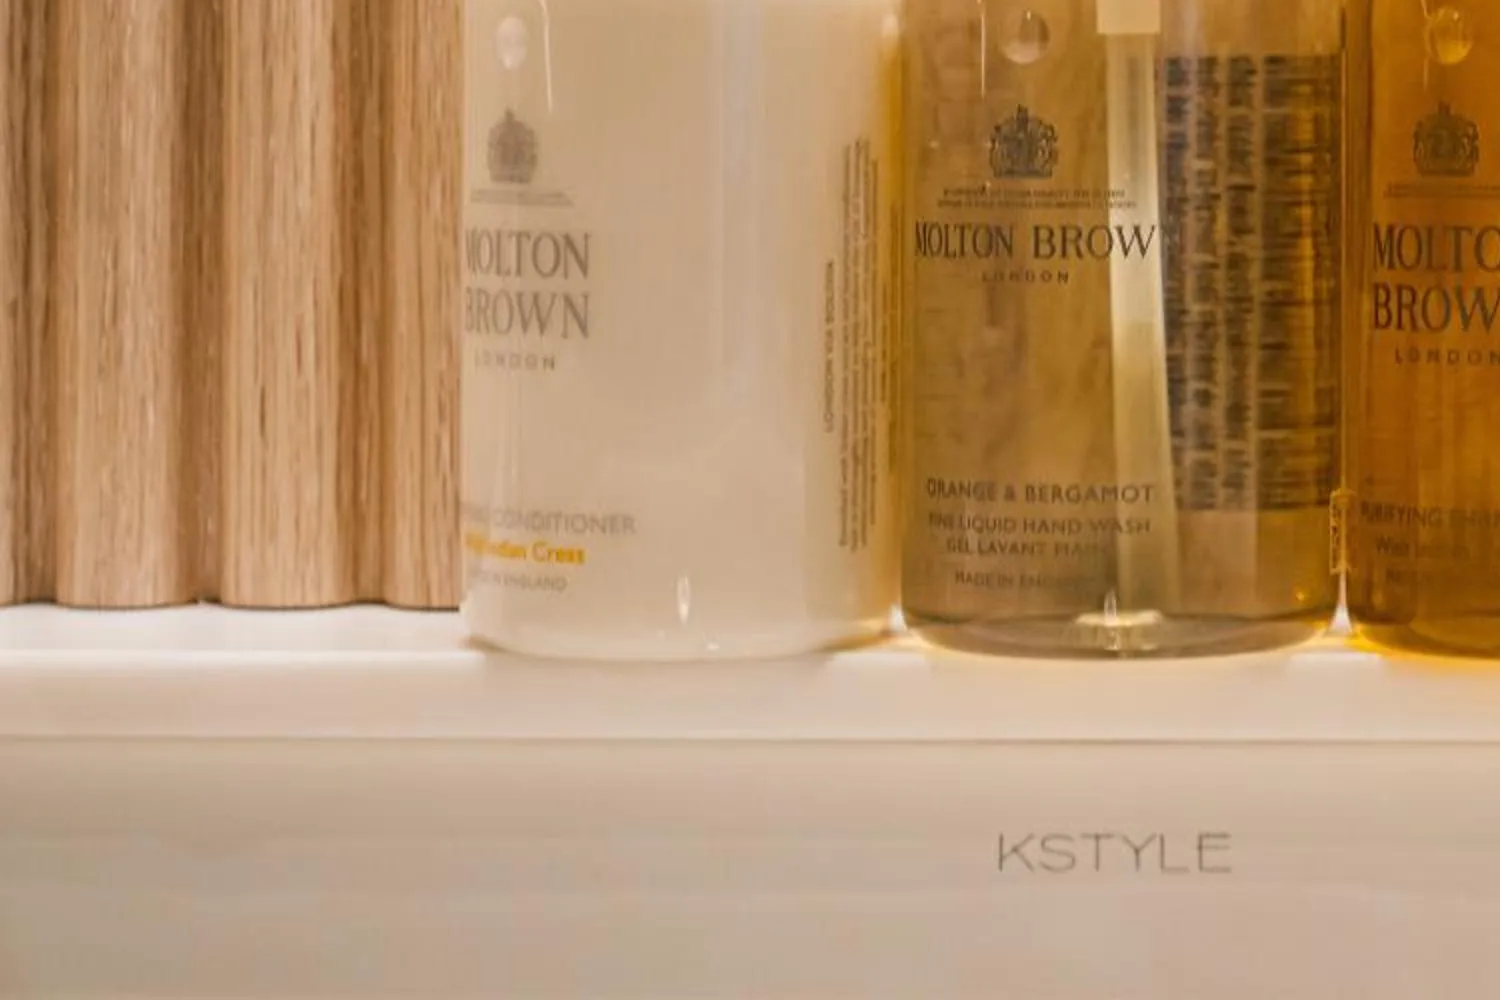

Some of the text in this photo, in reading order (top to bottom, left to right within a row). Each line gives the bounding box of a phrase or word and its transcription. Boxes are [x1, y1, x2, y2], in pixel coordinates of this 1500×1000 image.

[915, 219, 1014, 259] MOLTON
[981, 270, 1069, 285] LONDON
[926, 478, 998, 503] ORANGE
[1025, 484, 1154, 506] BERGAMOT
[493, 508, 638, 535] CONDITIONER
[957, 515, 1017, 534] LIQUID
[1023, 518, 1082, 537] HAND
[1088, 518, 1151, 536] WASH
[977, 538, 1046, 558] LAVANT
[998, 831, 1233, 874] KSTYLE
